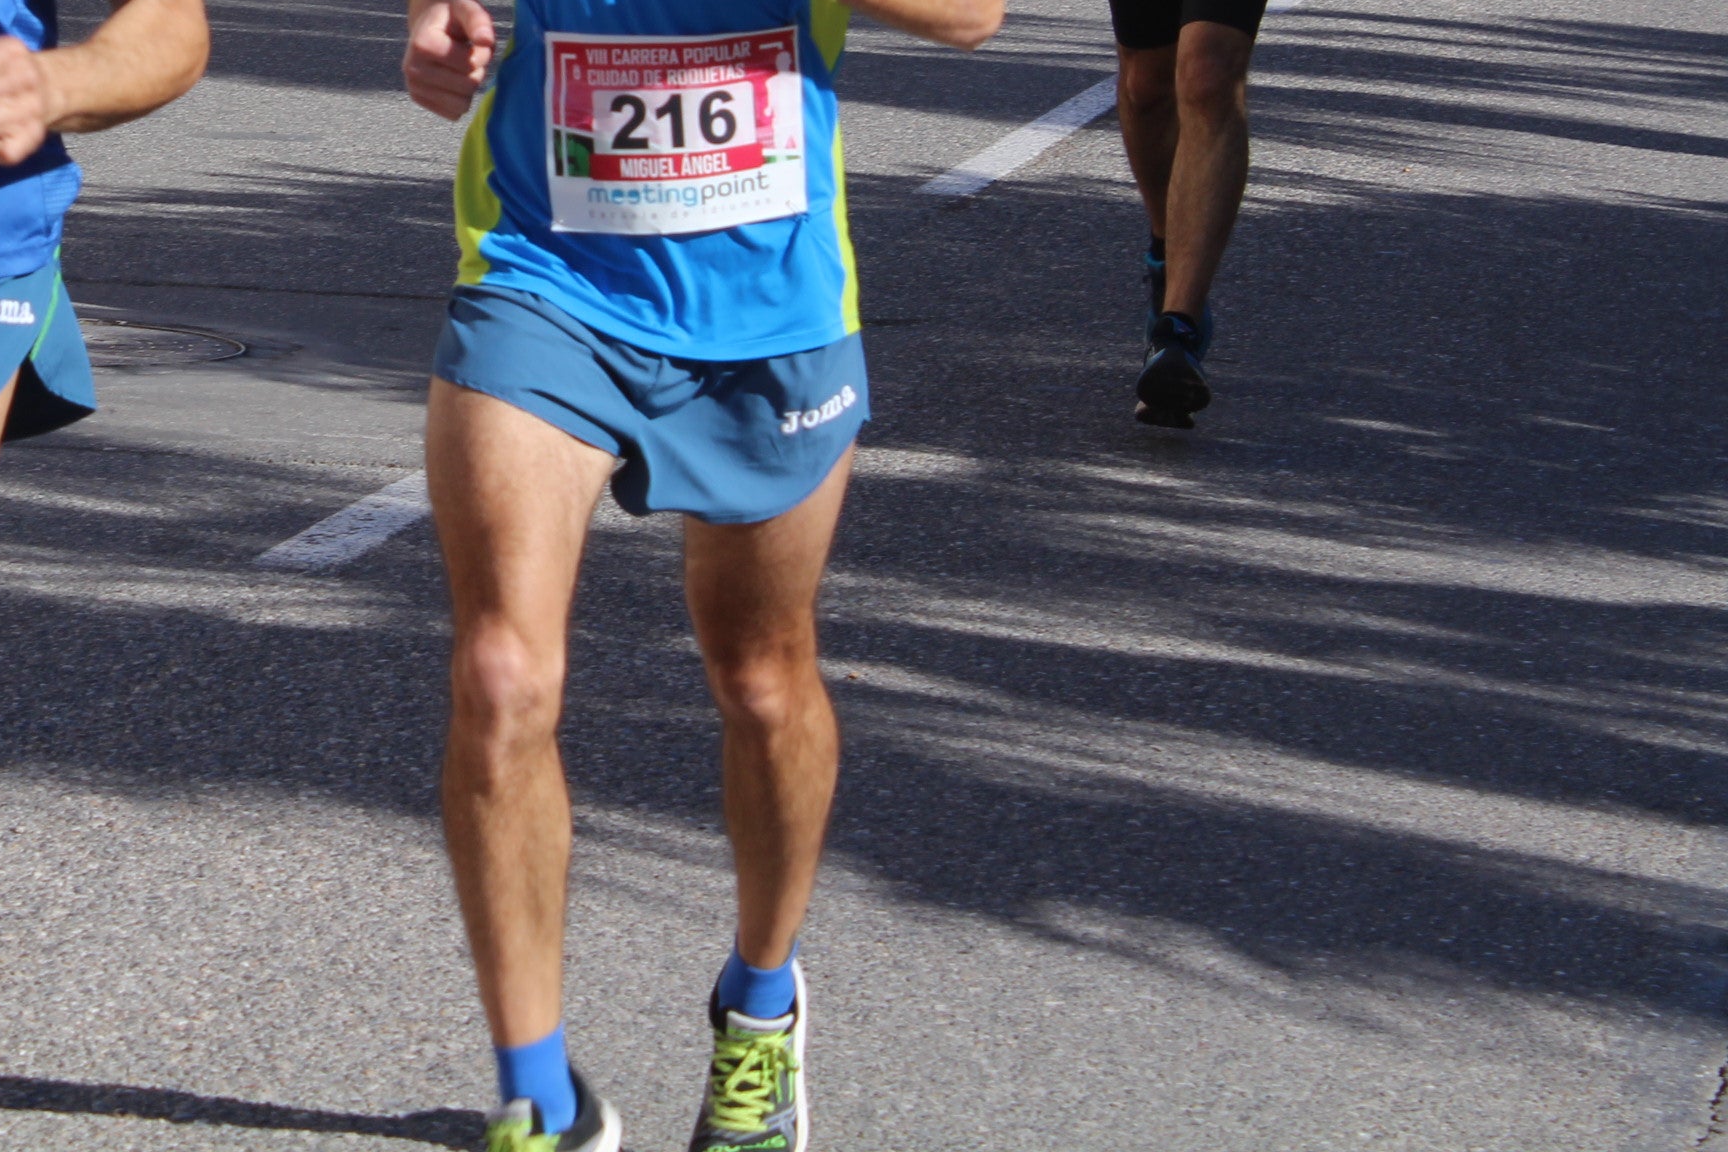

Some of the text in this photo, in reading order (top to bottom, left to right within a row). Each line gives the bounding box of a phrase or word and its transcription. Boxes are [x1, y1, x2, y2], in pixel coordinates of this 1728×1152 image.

[585, 40, 752, 66] VIII CARRERA POPULAR
[587, 62, 747, 87] CIUDAD DE ROQUETAS
[609, 90, 738, 150] 216
[619, 151, 732, 179] MIGUEL ÁNGEL
[587, 170, 771, 207] meetingpoint
